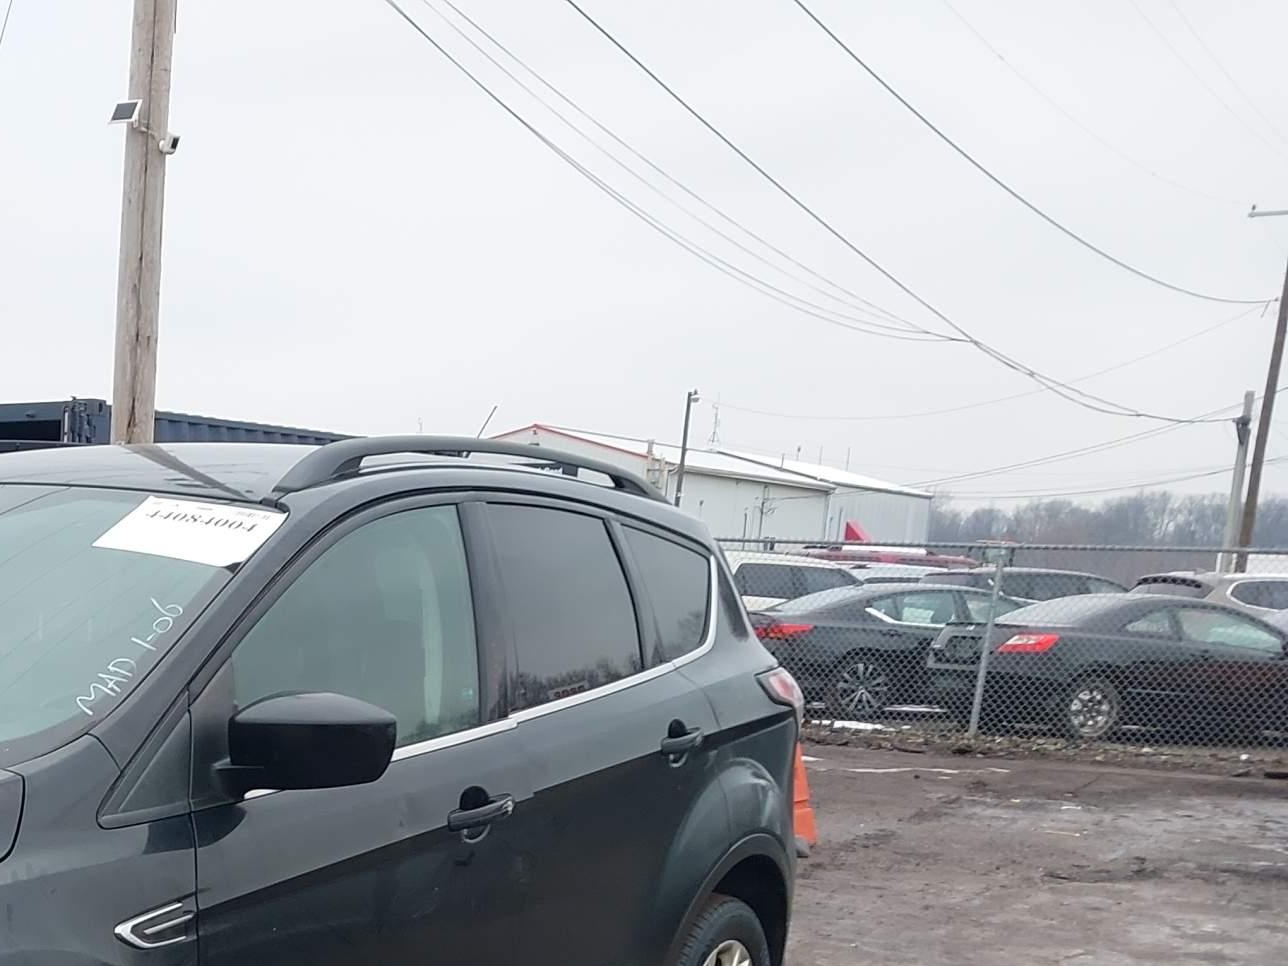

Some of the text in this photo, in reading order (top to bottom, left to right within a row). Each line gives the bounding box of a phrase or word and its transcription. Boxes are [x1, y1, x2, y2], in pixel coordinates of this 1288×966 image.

[145, 509, 258, 533] 44084004
[76, 597, 184, 716] MAD 1-06
